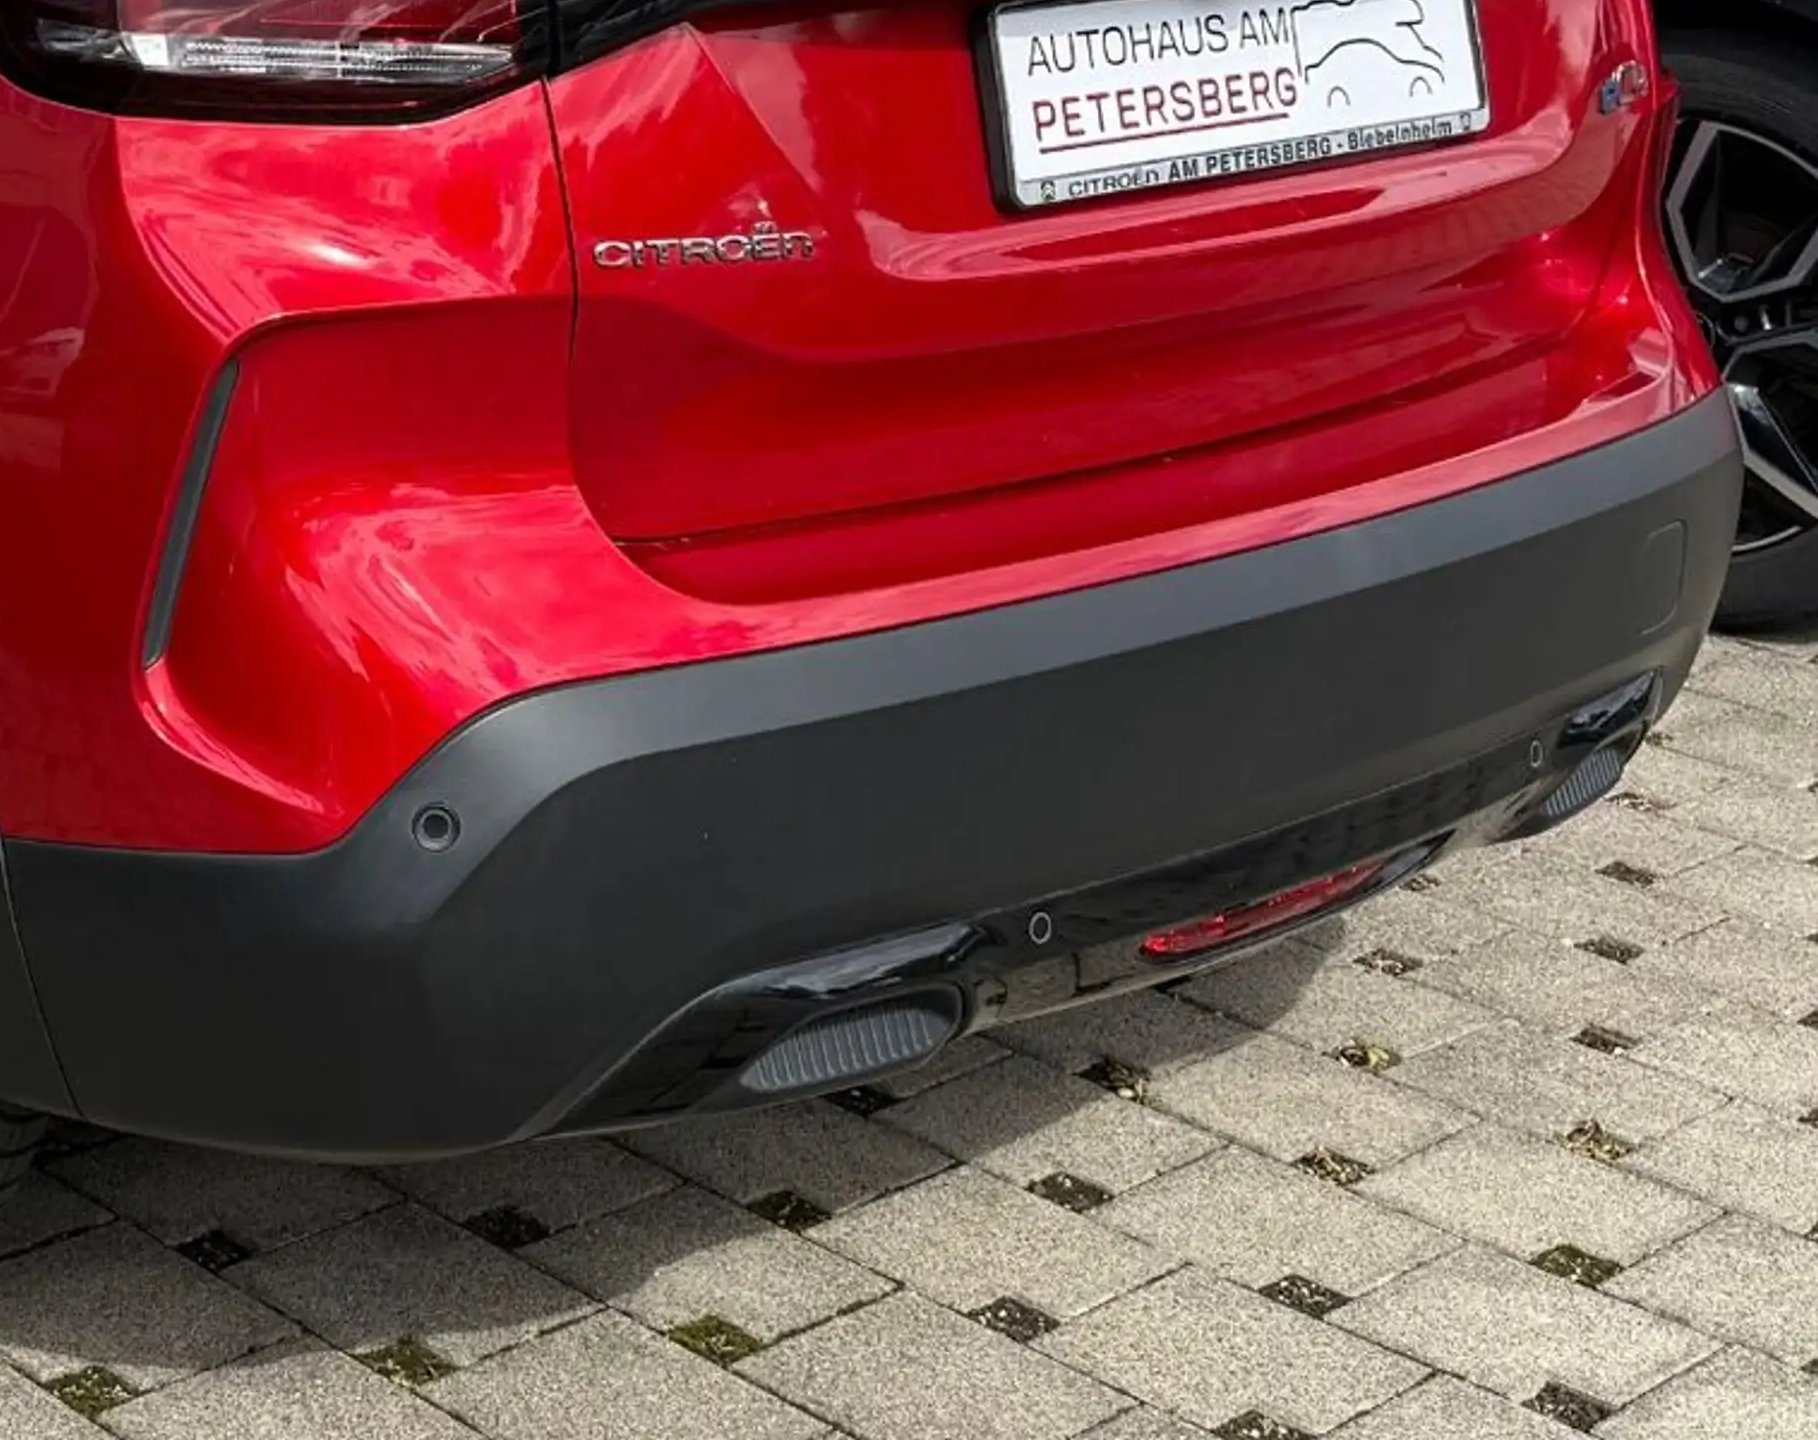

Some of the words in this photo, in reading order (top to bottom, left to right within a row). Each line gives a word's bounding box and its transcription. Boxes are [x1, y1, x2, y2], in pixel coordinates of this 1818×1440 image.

[1028, 14, 1229, 76] AUTOHAUS
[1239, 7, 1290, 49] AM
[1033, 67, 1298, 142] PETERSBERG
[1168, 159, 1199, 182] AM
[1206, 137, 1333, 174] PETERSBERG
[592, 220, 815, 268] CITROËN
